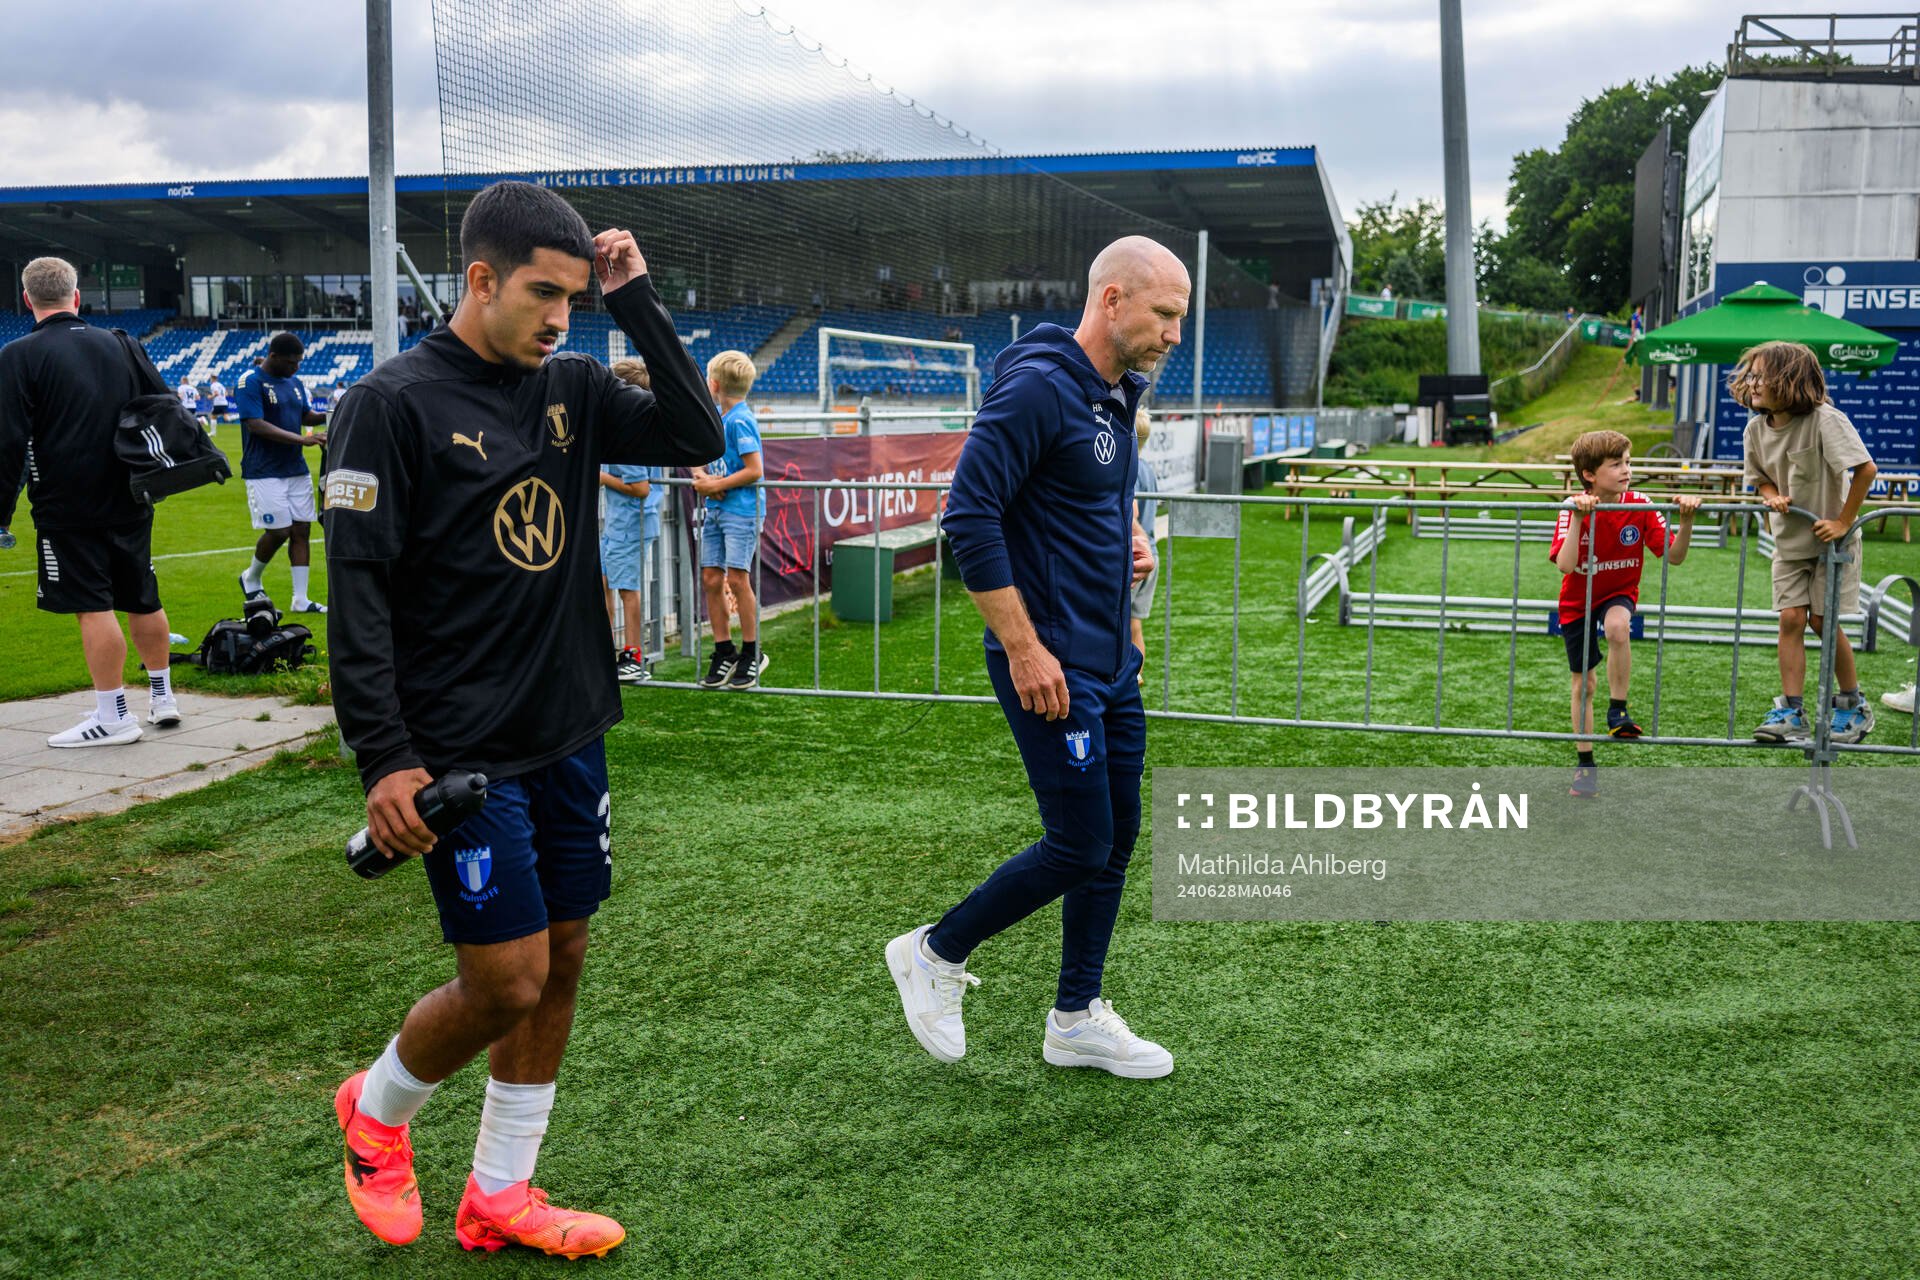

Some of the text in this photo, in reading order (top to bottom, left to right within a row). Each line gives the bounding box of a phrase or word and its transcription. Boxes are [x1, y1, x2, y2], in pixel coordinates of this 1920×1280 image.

[536, 173, 610, 187] MICHAEL
[705, 167, 795, 182] TRIBUNEN
[1829, 343, 1879, 361] Carlsberg
[1092, 403, 1103, 412] HR
[459, 885, 500, 902] Malmö FF
